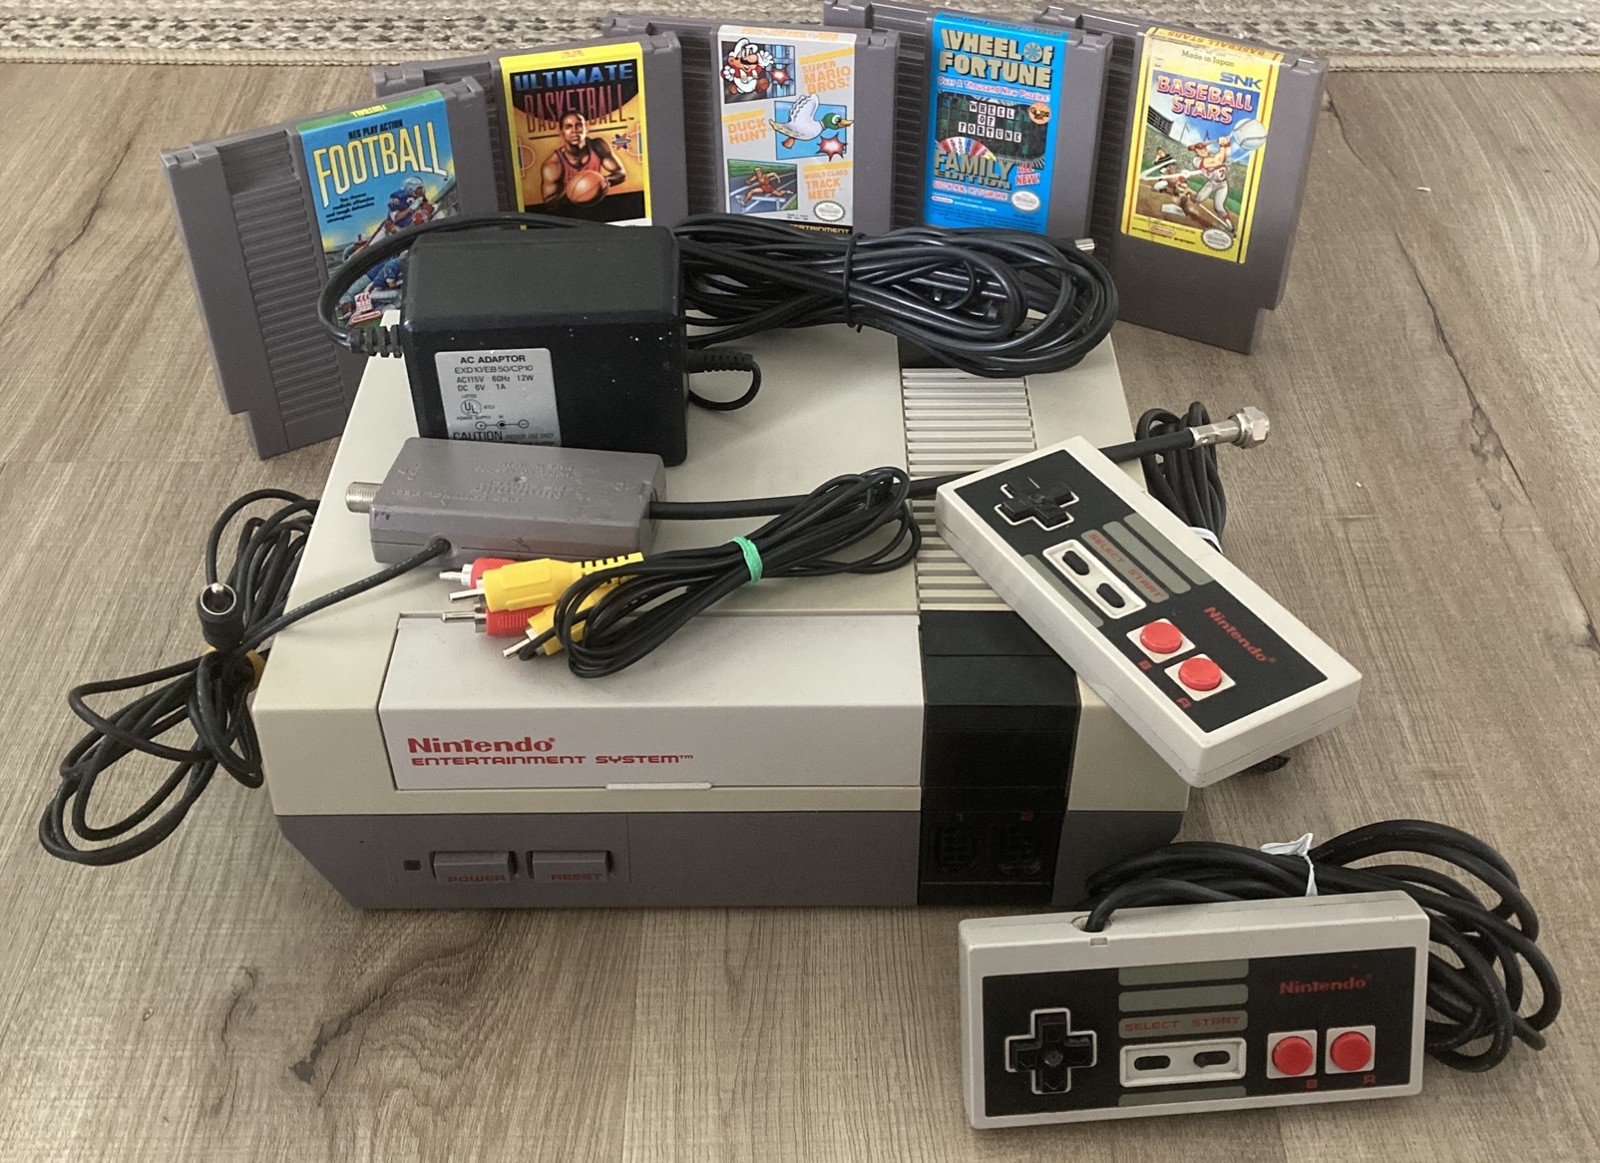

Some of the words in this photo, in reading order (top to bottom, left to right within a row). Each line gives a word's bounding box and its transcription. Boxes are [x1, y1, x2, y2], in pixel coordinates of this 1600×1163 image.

[941, 28, 1023, 62] WHEEL
[802, 60, 836, 73] SUPER
[1181, 49, 1203, 61] Made
[1203, 55, 1212, 63] in
[1212, 55, 1235, 68] Japan
[513, 62, 634, 92] ULTIMATE
[803, 65, 851, 84] MARIO
[939, 50, 1054, 90] FORTUNE
[938, 75, 955, 86] Over
[956, 79, 964, 88] A
[964, 81, 1001, 94] Thousand
[1001, 86, 1019, 97] New
[1219, 71, 1263, 90] SNK
[1156, 74, 1254, 112] BASEBALL
[523, 83, 628, 134] BASKETBALL
[968, 100, 1016, 120] WHEEL
[1171, 96, 1233, 125] STARS
[362, 124, 378, 137] PLAY
[379, 118, 404, 132] ACTION
[728, 117, 768, 135] DUCK
[977, 114, 996, 128] OF
[729, 128, 767, 145] HUNT
[958, 121, 1022, 143] FORTUNE
[312, 121, 448, 210] FOOTBALL
[827, 169, 849, 177] CLASS
[934, 149, 1015, 182] FAMILY
[805, 177, 840, 190] TRACK
[807, 188, 837, 201] MEET
[460, 356, 475, 364] AC
[478, 354, 526, 364] ADAPTOR
[456, 376, 485, 384] AC115V
[491, 375, 511, 383] 60Hz
[517, 374, 534, 382] 12W
[457, 384, 469, 392] DC
[496, 383, 506, 391] 1A
[453, 430, 503, 441] CAUTION
[1088, 532, 1125, 565] SELECT
[1127, 567, 1162, 598] START
[1203, 606, 1268, 663] Nintendo
[1176, 696, 1192, 710] A
[407, 736, 555, 754] Nintendo
[411, 755, 587, 767] ENTERTAINMENT
[448, 874, 507, 884] POWER
[550, 872, 602, 882] RESET
[1278, 975, 1367, 996] Nintendo
[1123, 1020, 1180, 1033] SELECT
[1191, 1015, 1242, 1029] START
[1305, 1078, 1319, 1090] B
[1362, 1073, 1377, 1086] A
